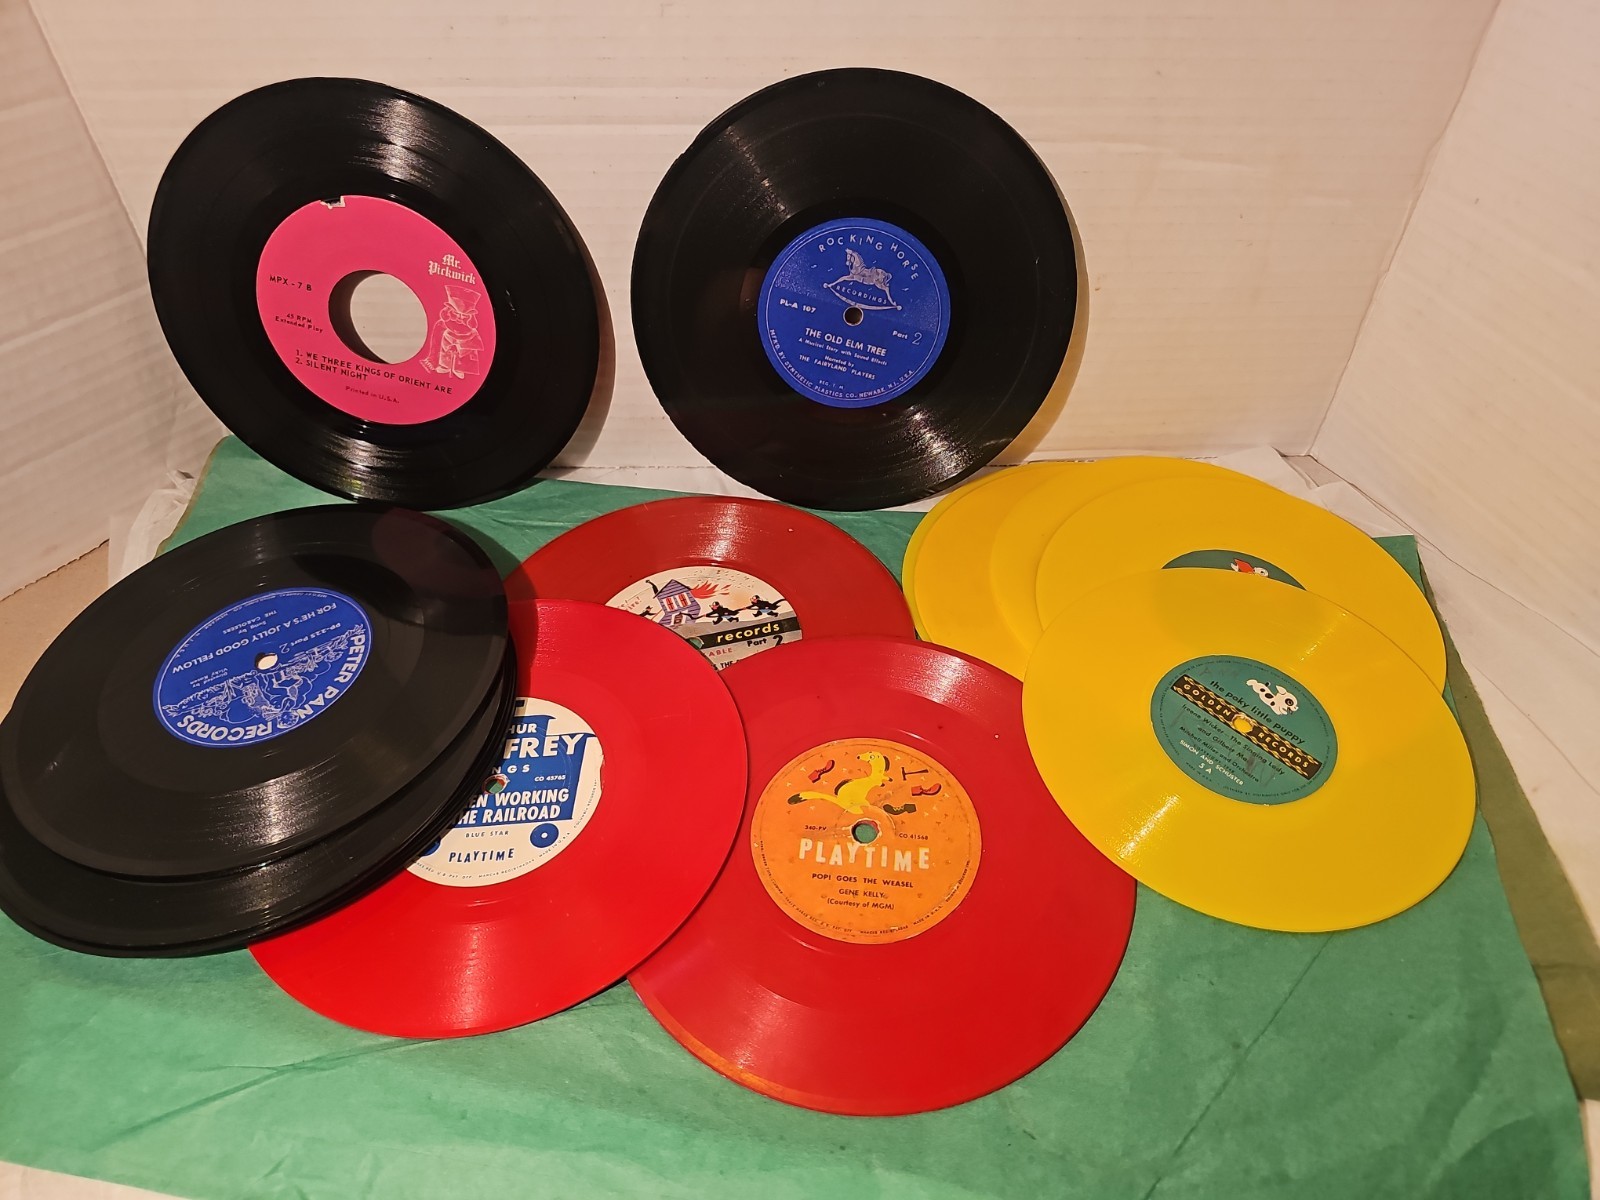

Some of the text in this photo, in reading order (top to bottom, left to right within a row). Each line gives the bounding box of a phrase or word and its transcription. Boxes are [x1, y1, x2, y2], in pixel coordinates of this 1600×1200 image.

[442, 254, 461, 270] Mr.
[818, 234, 919, 280] ROCKING HORSE
[269, 275, 289, 286] MPX
[428, 260, 476, 285] Pickwick
[836, 285, 888, 305] RECORDINGS
[780, 298, 817, 313] PL-A 107
[275, 316, 324, 334] Extended Play
[805, 327, 887, 357] THE OLD ELM TREE
[892, 330, 923, 346] Part 2
[804, 339, 825, 349] Musical
[826, 345, 839, 353] Story
[854, 353, 870, 361] Sound
[813, 359, 848, 372] FAIRYLAND
[851, 369, 876, 380] PLAYERS
[824, 355, 847, 366] Narrated
[306, 360, 338, 374] SILENT
[341, 369, 369, 381] NIGHT
[306, 351, 319, 361] WE
[322, 355, 352, 369] THREE
[355, 364, 381, 377] KINGS
[384, 371, 397, 380] OF
[398, 375, 431, 389] ORIENT
[434, 384, 453, 395] ARE
[345, 386, 369, 396] Printed
[814, 385, 843, 398] PLASTICS
[264, 610, 278, 618] THE
[316, 602, 337, 615] FOR
[282, 620, 292, 628] A
[293, 611, 316, 625] HE'S
[251, 625, 281, 643] JOLLY
[290, 636, 309, 647] Part
[716, 623, 780, 643] records
[747, 634, 784, 648] Part 2
[215, 638, 250, 656] GOOD
[279, 642, 290, 654] 2
[172, 652, 214, 674] FELLOW
[177, 633, 366, 741] PETER PAN RECORDS
[1210, 680, 1225, 693] the
[1251, 705, 1273, 723] little
[1273, 722, 1306, 745] puppy
[1183, 684, 1309, 768] GOLDEN RECORDS
[1179, 726, 1203, 743] Mitchell
[1202, 741, 1219, 755] Miller
[1219, 753, 1232, 763] and
[1231, 761, 1259, 783] Orchestra
[1202, 717, 1225, 734] Wicker
[1230, 735, 1241, 746] The
[1242, 744, 1268, 764] Singing
[1268, 761, 1286, 776] Lady
[1179, 739, 1199, 756] SIMON
[1200, 754, 1214, 765] AND
[1215, 764, 1244, 786] SCHUSTER
[494, 788, 570, 810] WORKING
[482, 804, 561, 824] RAILROAD
[448, 848, 515, 864] PLAYTIME
[798, 837, 931, 873] PLAYTIME
[836, 875, 858, 883] GOES
[863, 877, 878, 885] THE
[882, 879, 914, 888] WEASEL
[838, 888, 860, 897] GENE
[827, 897, 860, 908] (Courtesy
[871, 903, 895, 911] MGM)
